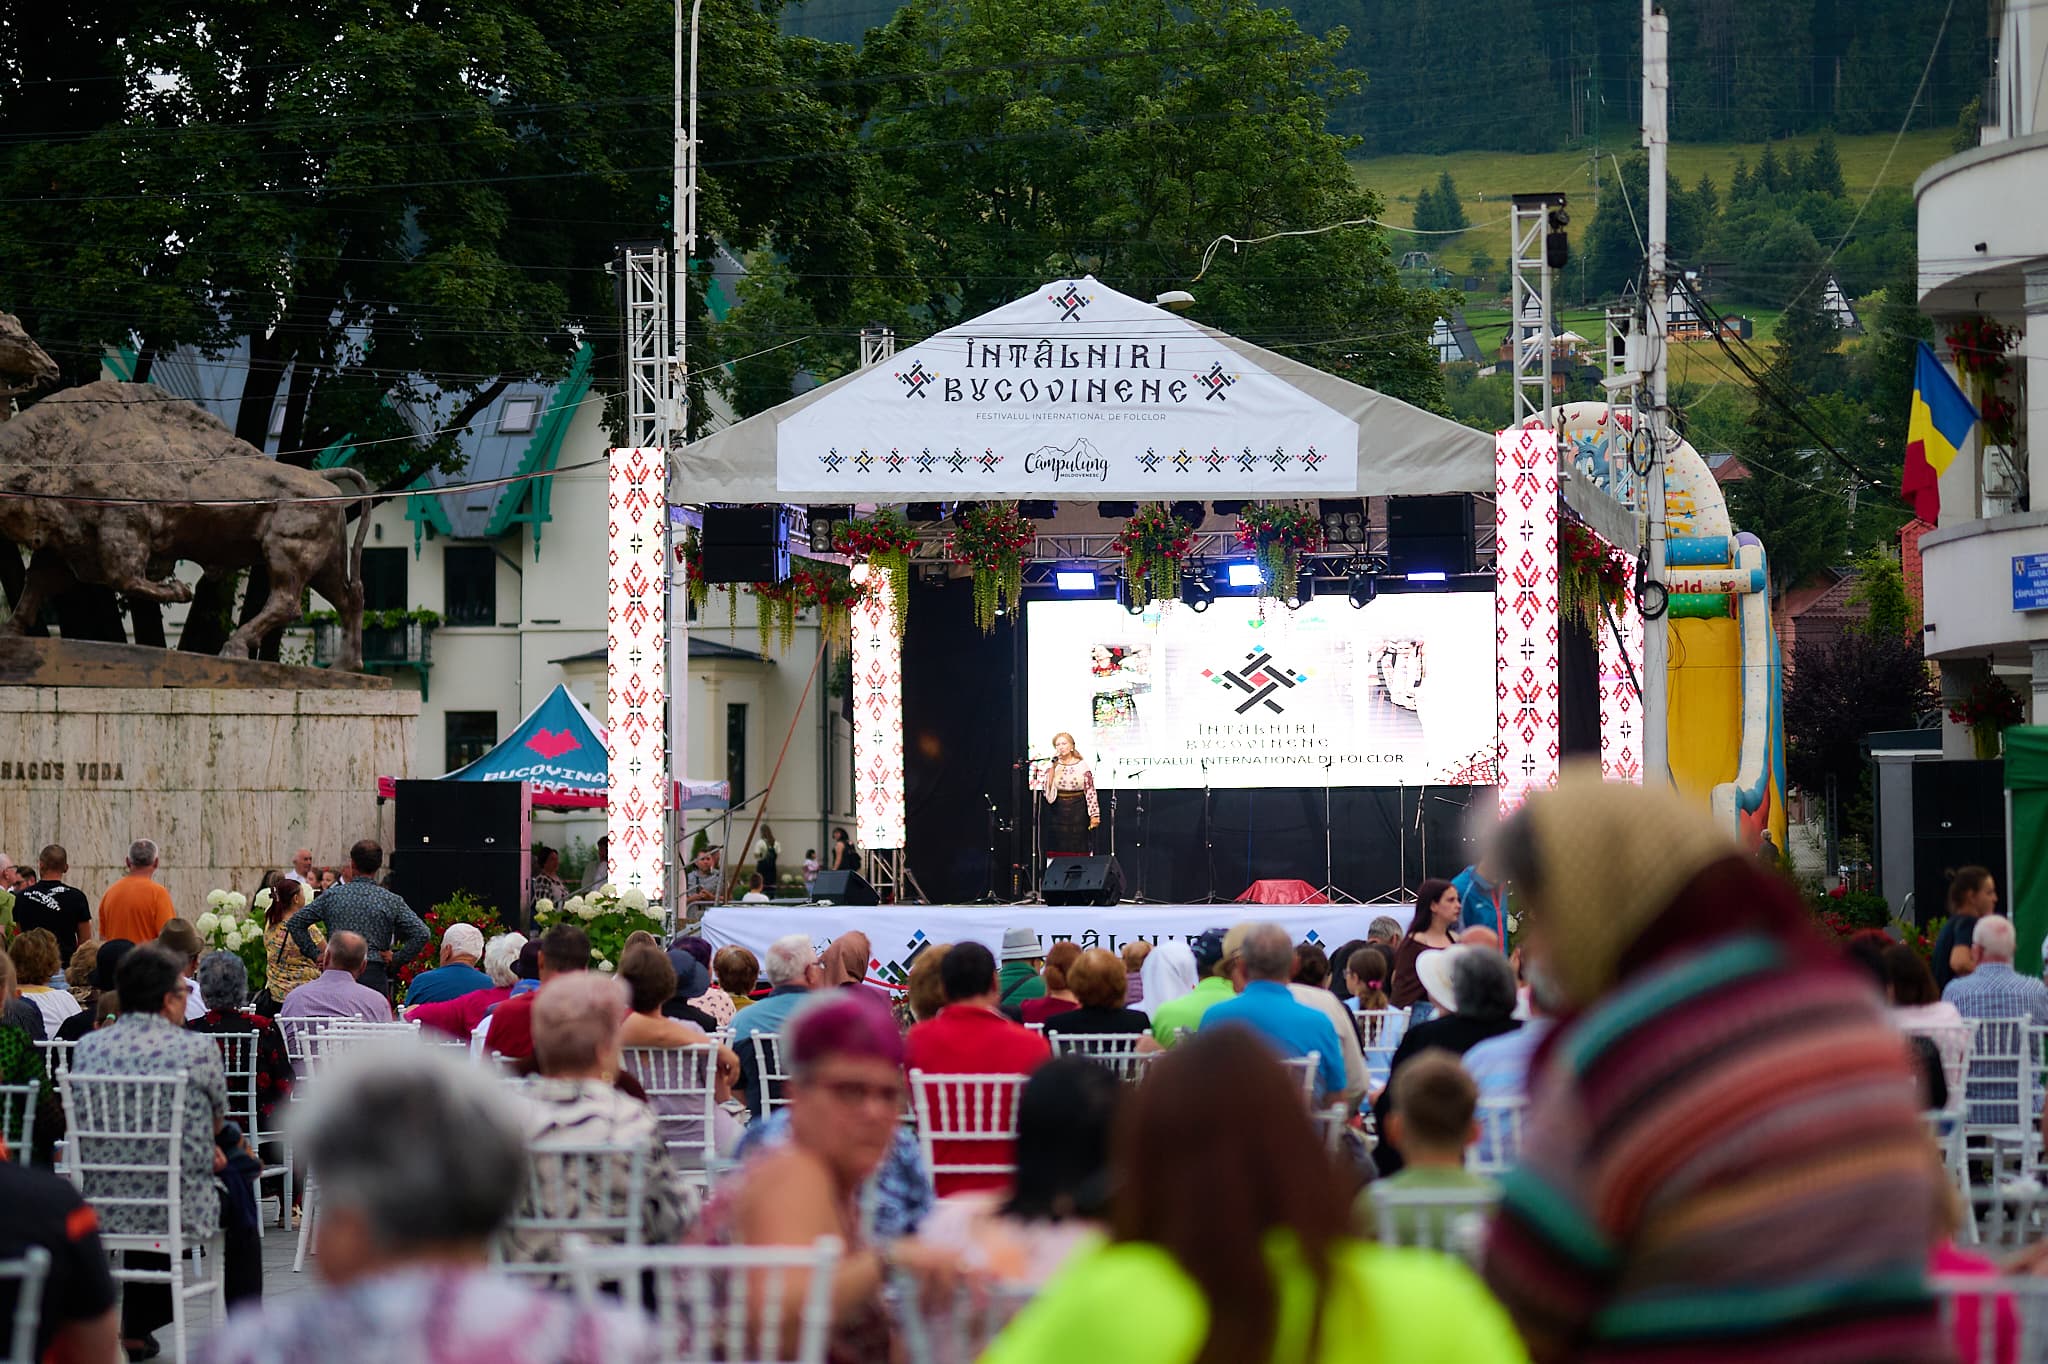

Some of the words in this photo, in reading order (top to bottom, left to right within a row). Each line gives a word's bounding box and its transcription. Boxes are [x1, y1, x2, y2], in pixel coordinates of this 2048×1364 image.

[966, 337, 1167, 369] ÎNTÂLNIRI
[976, 412, 1030, 421] FESTIVALUL
[1032, 412, 1104, 421] INTERNATIONAL
[1108, 413, 1121, 421] DE
[1123, 413, 1167, 421] FOLCLOR
[1024, 451, 1110, 482] Câmpulung
[1666, 579, 1702, 594] orld
[483, 763, 608, 784] BUCOVINA
